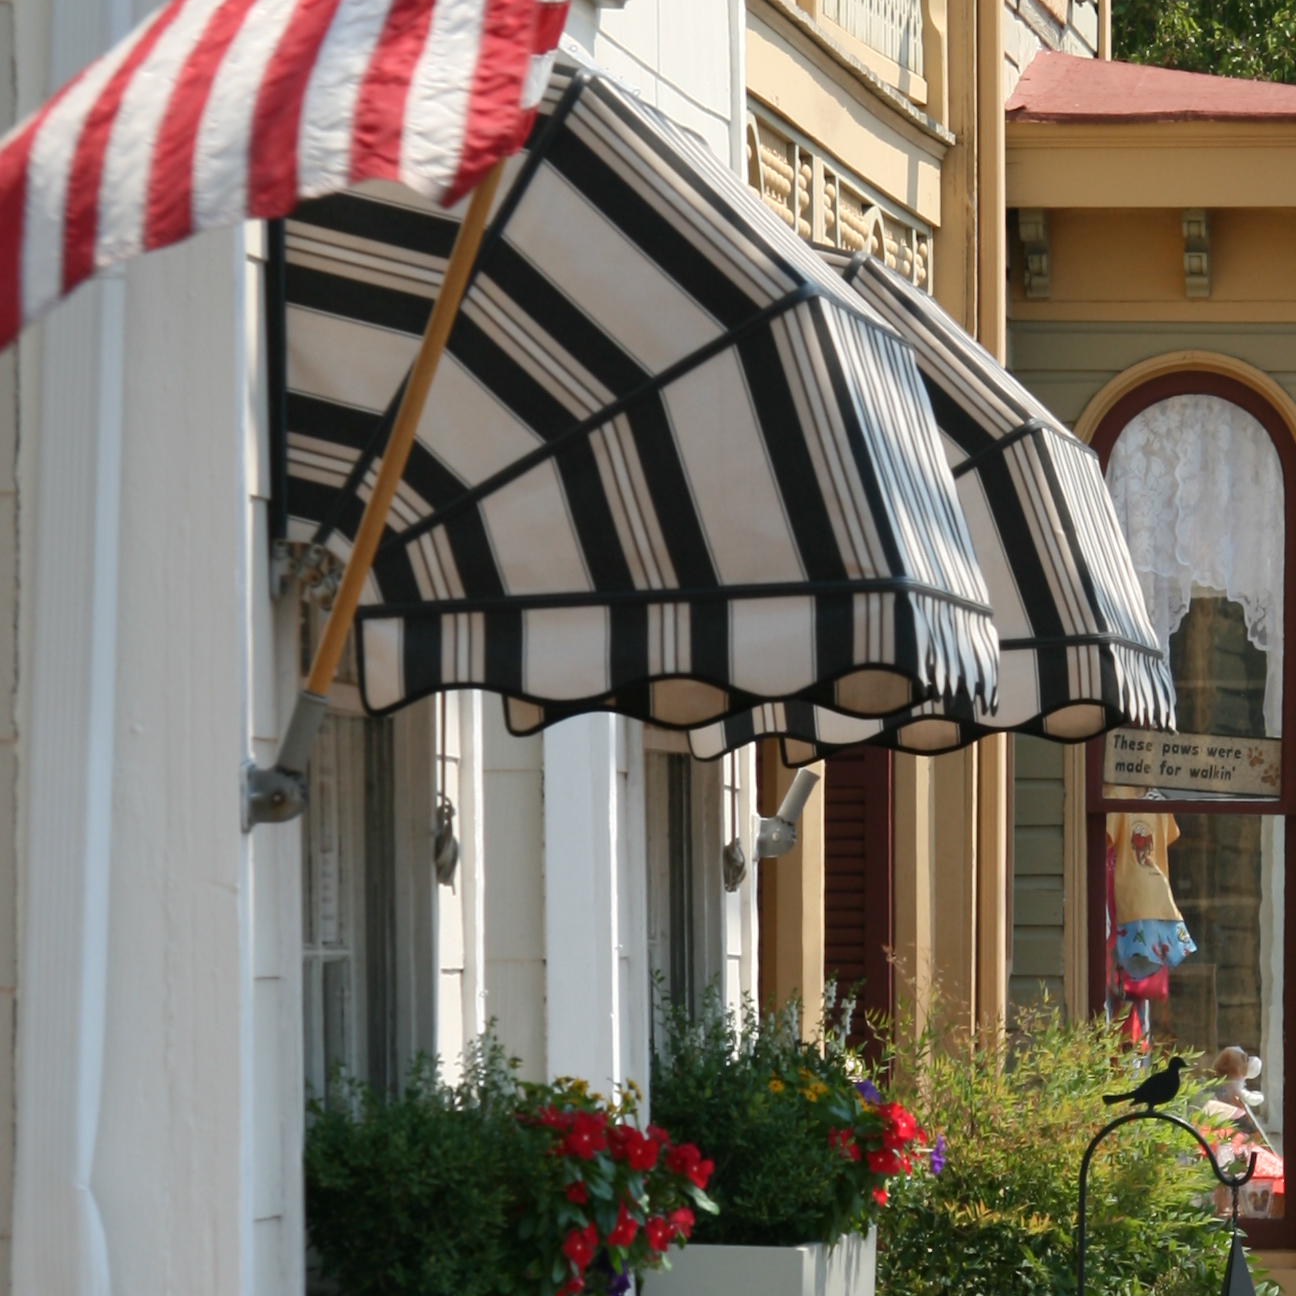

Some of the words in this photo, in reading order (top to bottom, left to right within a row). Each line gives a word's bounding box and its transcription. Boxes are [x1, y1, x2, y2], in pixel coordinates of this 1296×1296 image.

[1113, 734, 1153, 752] These
[1162, 742, 1200, 757] paws
[1207, 746, 1242, 760] were
[1115, 759, 1151, 775] made
[1159, 760, 1182, 777] for
[1189, 765, 1236, 781] walkin'
